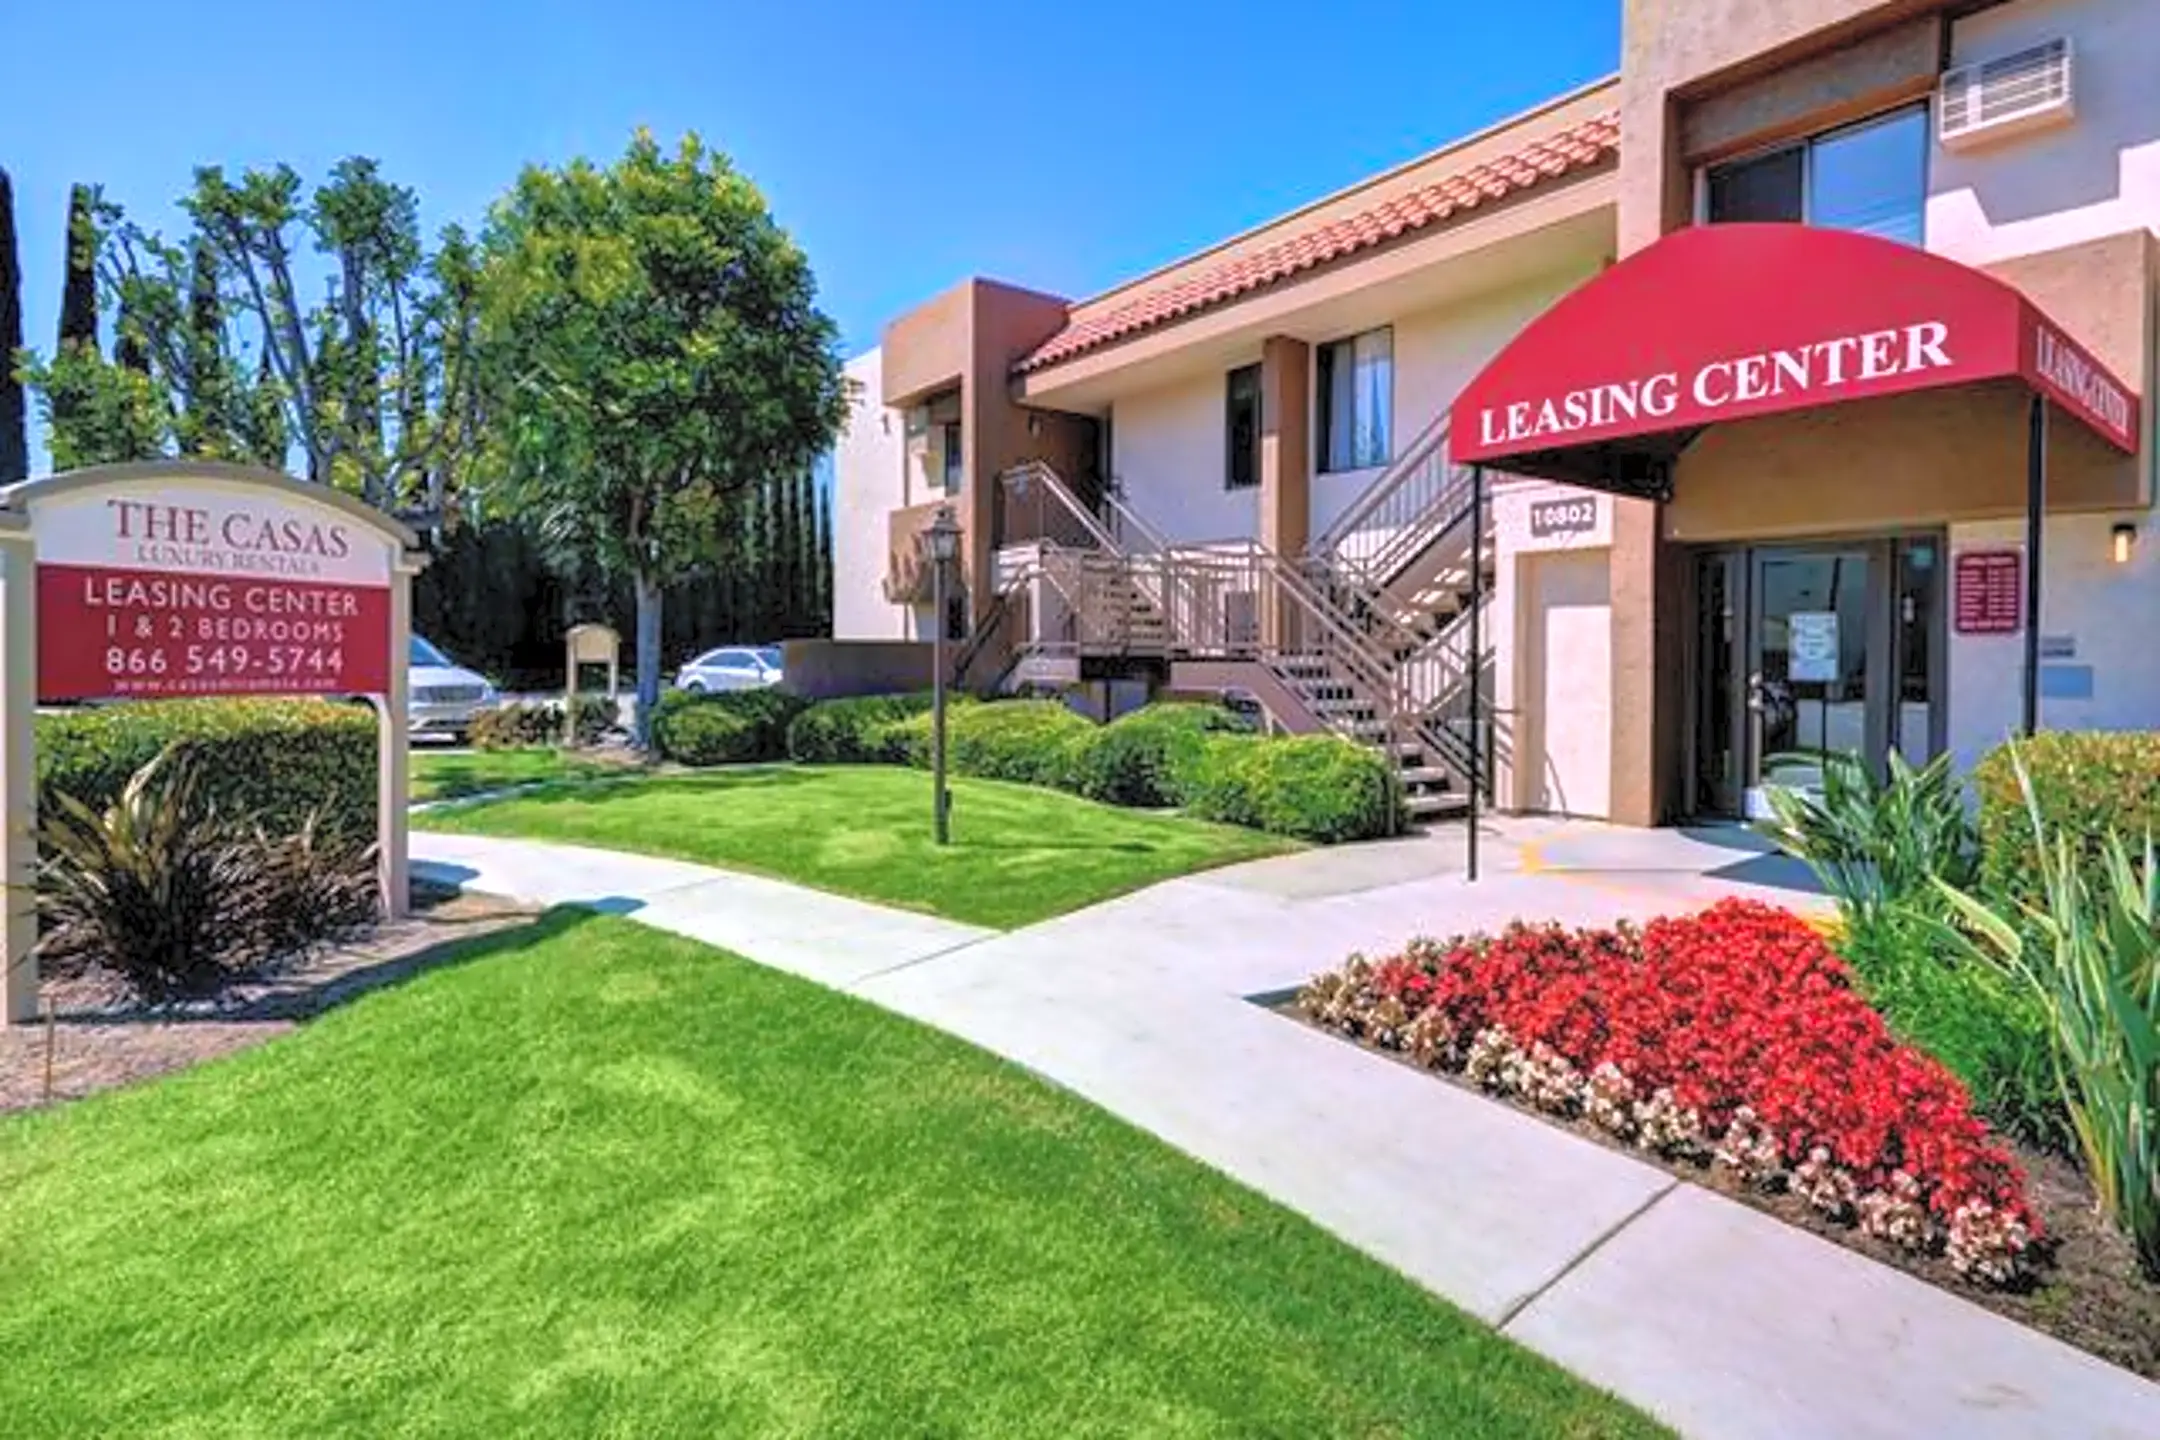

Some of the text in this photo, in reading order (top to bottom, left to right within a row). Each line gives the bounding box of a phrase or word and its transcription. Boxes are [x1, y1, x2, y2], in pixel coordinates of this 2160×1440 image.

[1479, 320, 1953, 446] LEASING CENTER
[107, 500, 349, 559] THE CASAS
[138, 544, 226, 570] LUXURY
[85, 577, 359, 616] LEASING CENTER
[134, 614, 153, 639] &
[168, 615, 185, 639] 2
[198, 617, 344, 643] BEDROOMS
[106, 645, 344, 676] 866 549-5744
